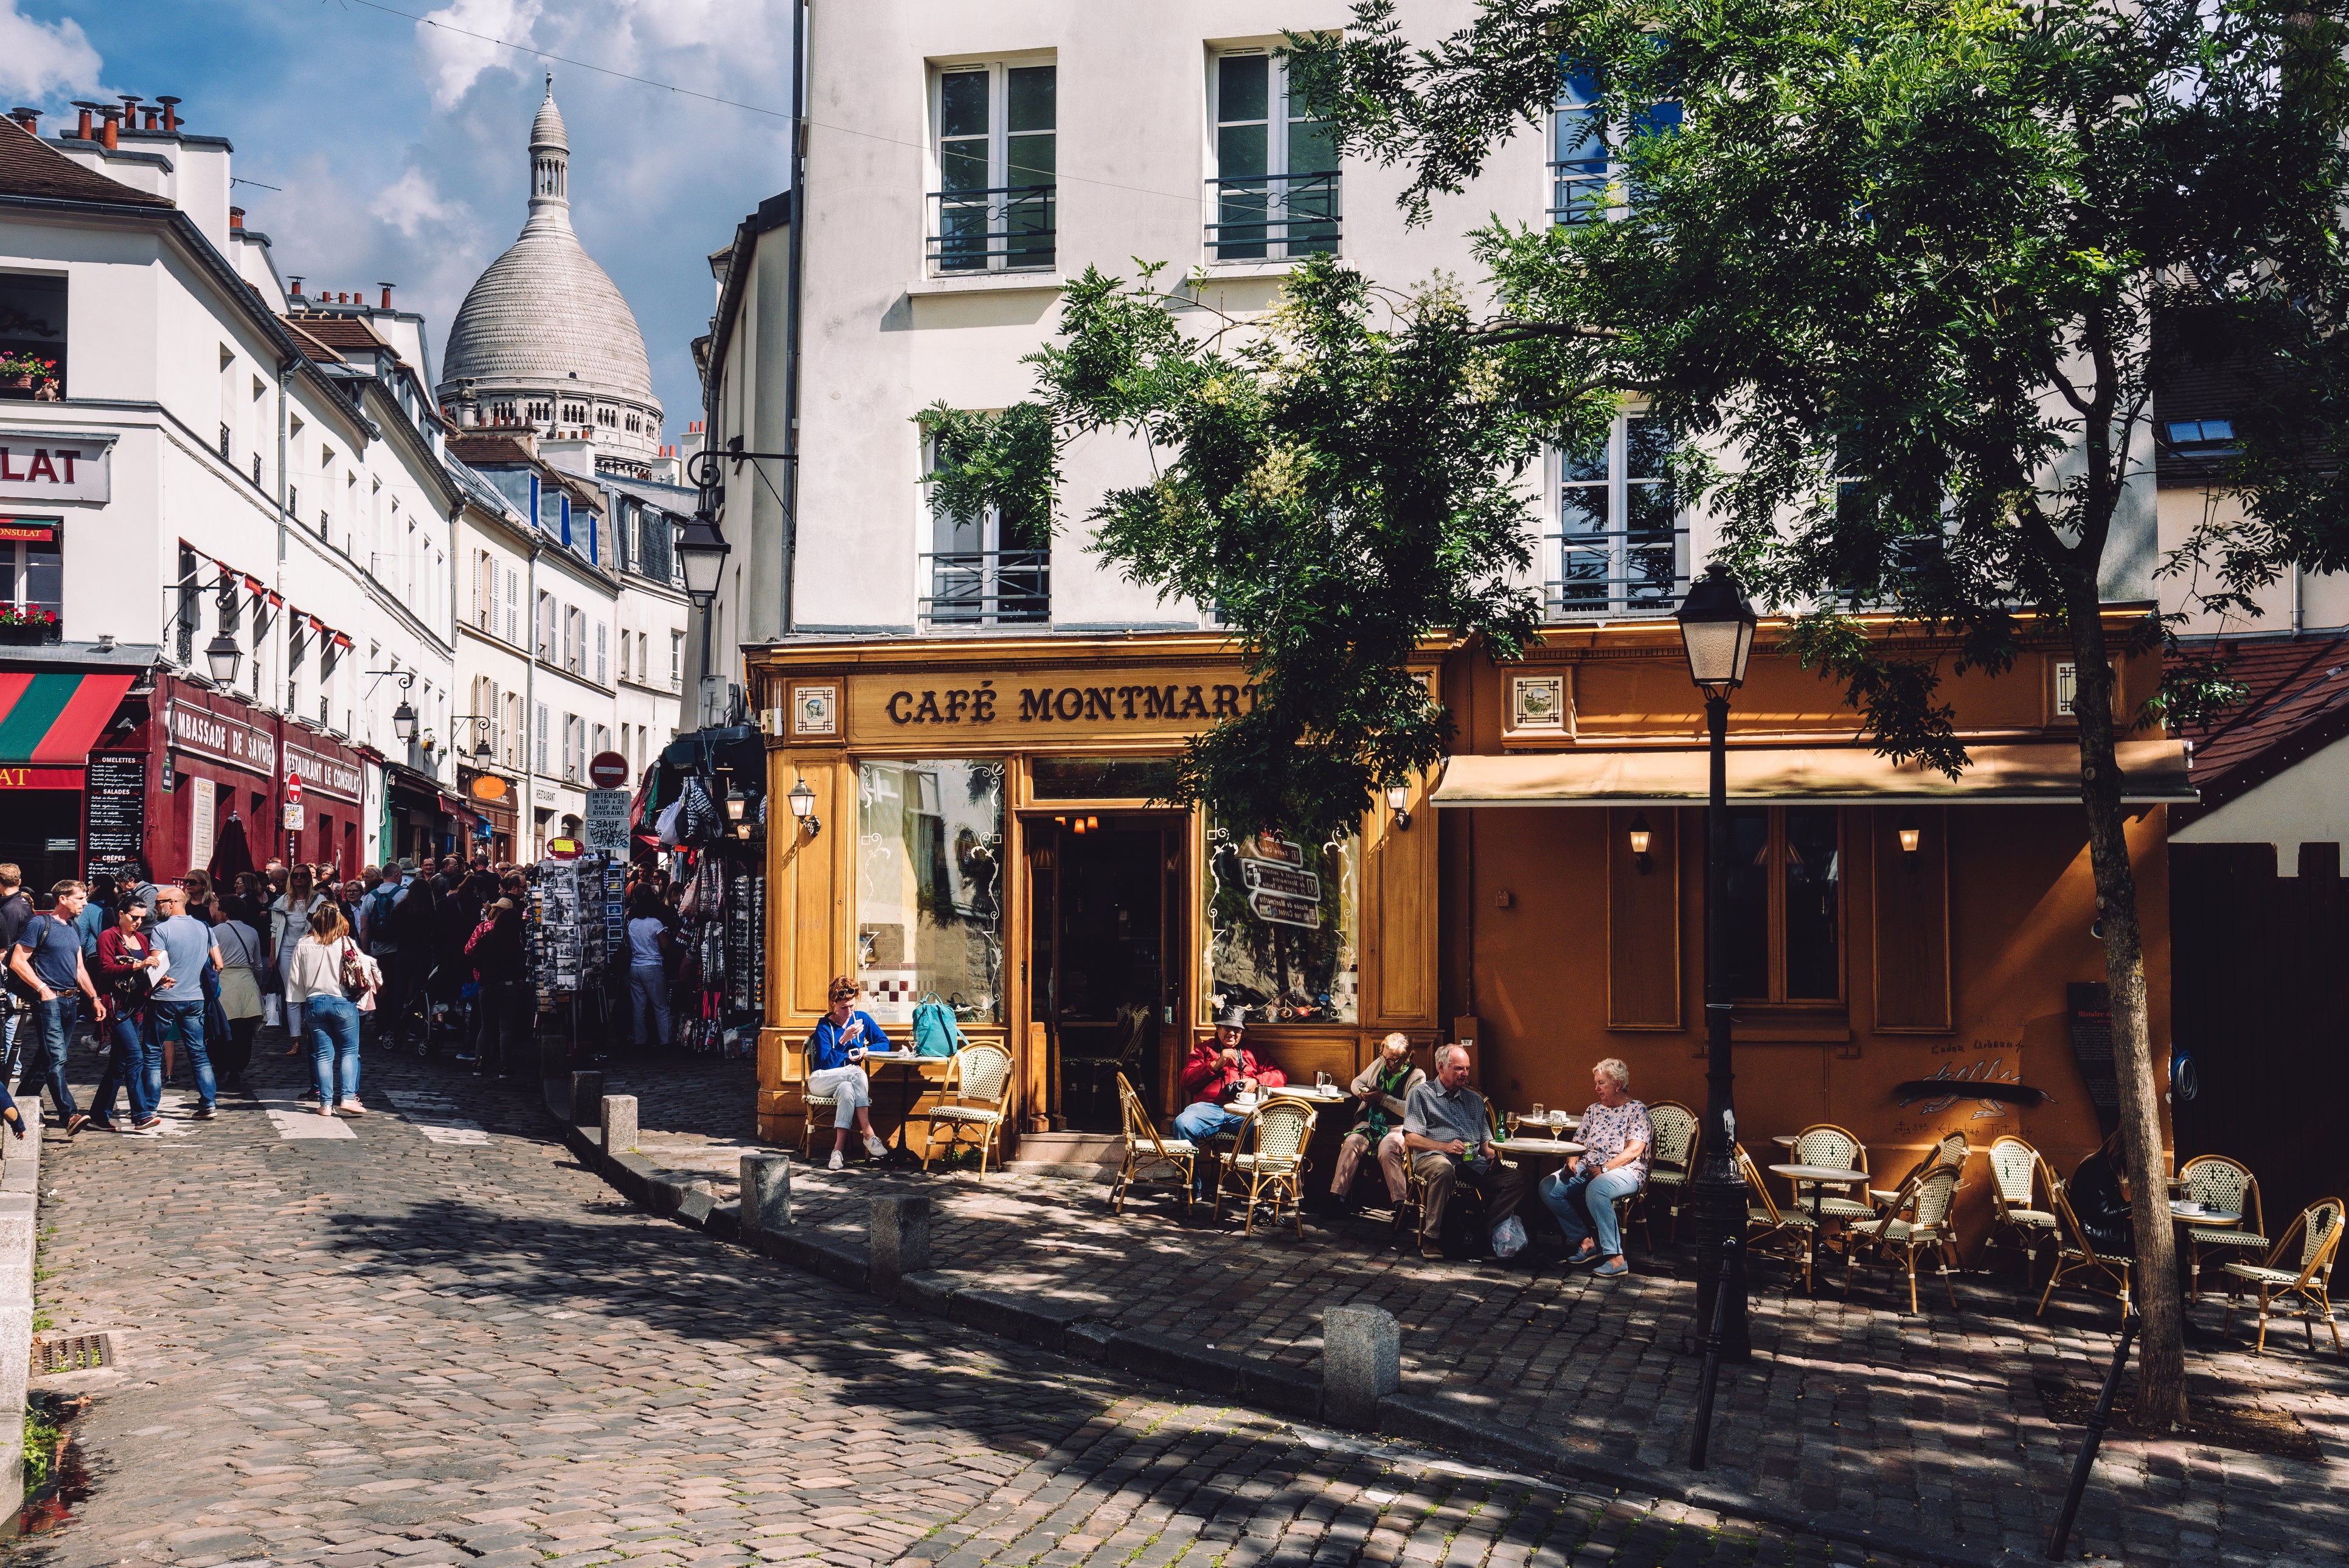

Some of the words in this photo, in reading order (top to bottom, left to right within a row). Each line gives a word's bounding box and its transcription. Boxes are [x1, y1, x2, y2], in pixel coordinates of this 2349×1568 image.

[0, 447, 81, 484] LAT
[886, 680, 997, 724] CAFÉ
[1019, 684, 1265, 721] MONTMART
[171, 710, 226, 750] AMBASSADE
[233, 730, 242, 755] DE
[248, 736, 271, 766] SAVOIE
[0, 768, 31, 785] AT
[285, 752, 322, 783] RESTAURANT
[324, 765, 331, 786] LE
[333, 769, 359, 794] CONSULAT
[536, 789, 555, 802] RESTAURANT
